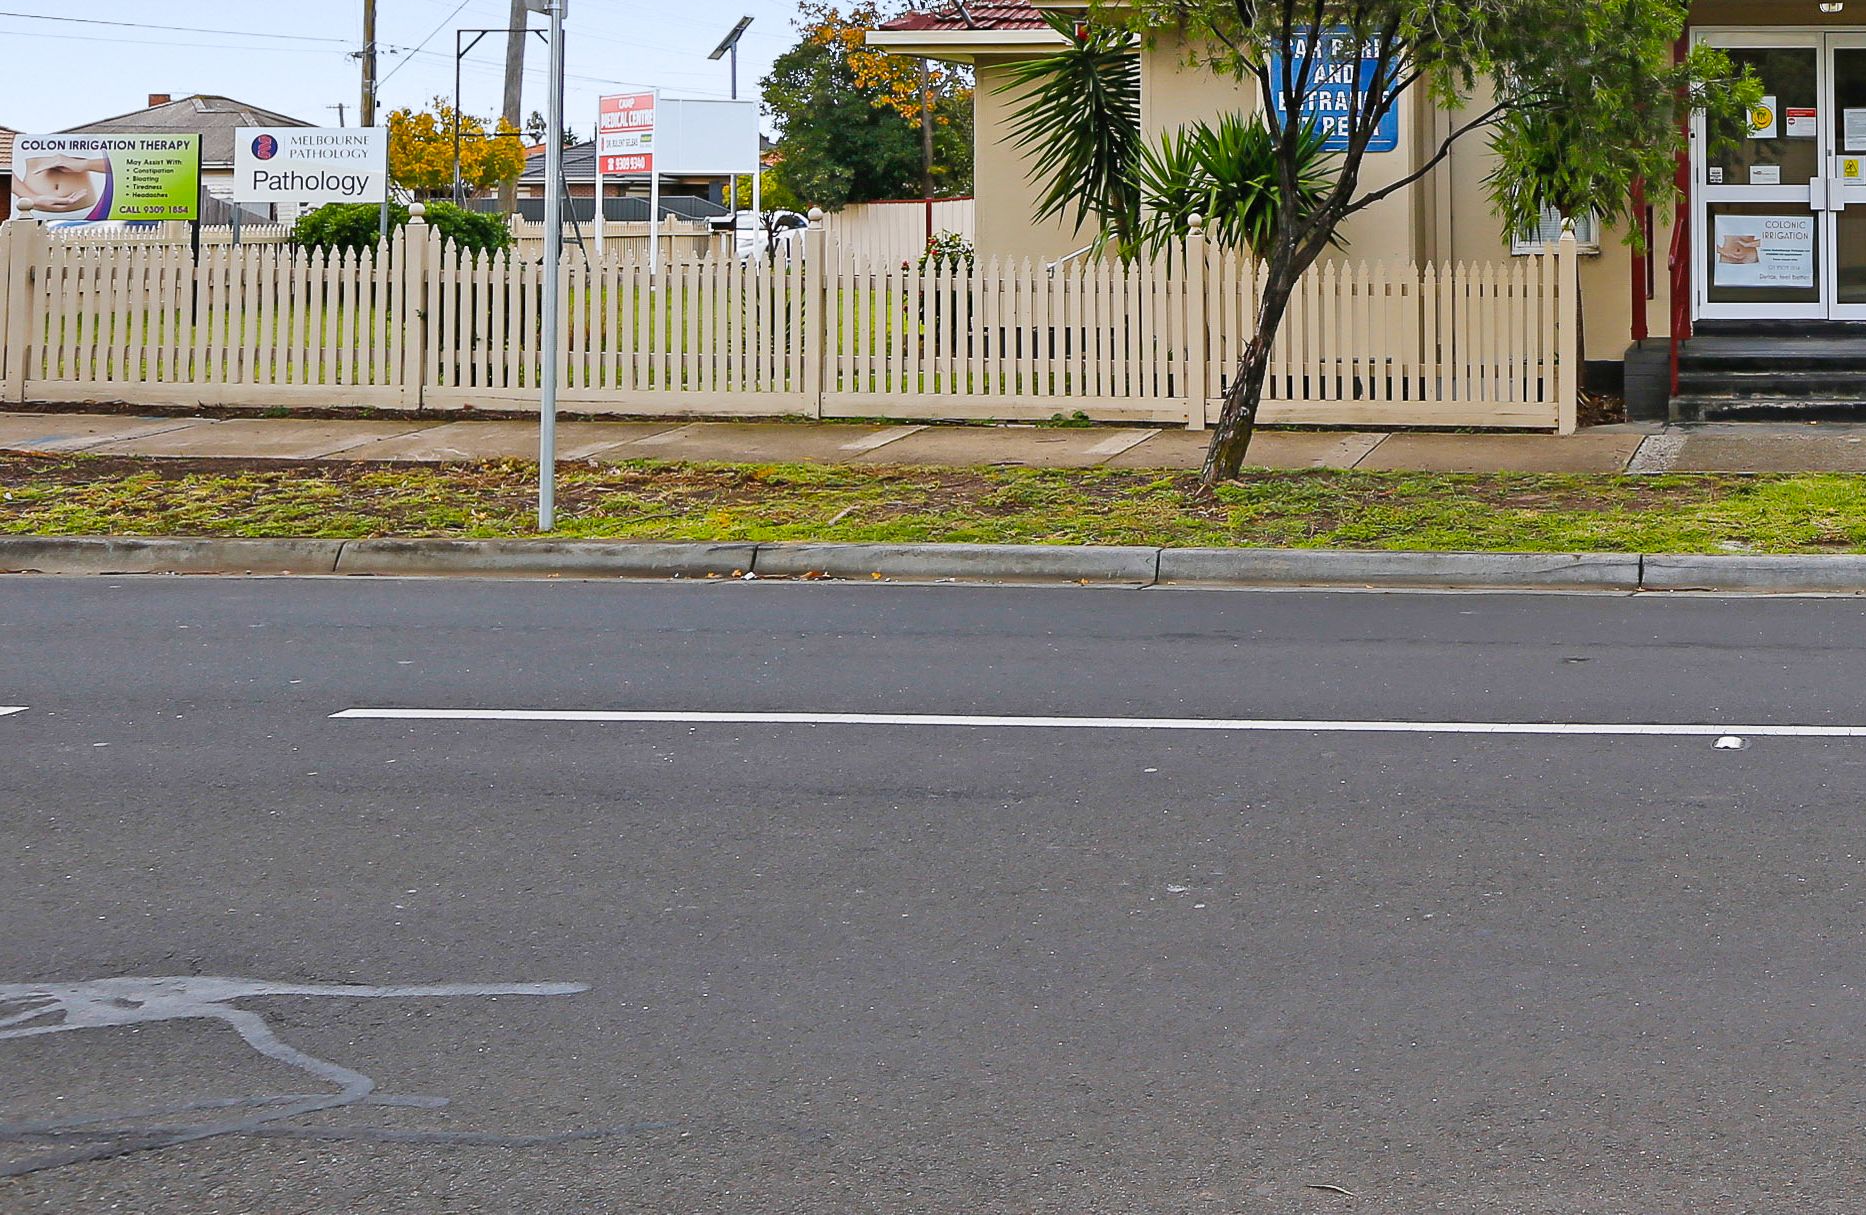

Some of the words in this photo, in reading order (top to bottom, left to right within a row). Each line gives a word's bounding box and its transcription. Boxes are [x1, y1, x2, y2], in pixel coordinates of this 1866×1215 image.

[1313, 64, 1355, 84] AND
[601, 111, 628, 129] MEDICAL
[629, 109, 653, 127] CENTRE
[290, 135, 369, 145] MELBOURNE
[21, 140, 66, 151] COLON
[69, 140, 136, 151] IRRIGATION
[140, 140, 191, 150] THERAPY
[290, 148, 369, 159] PATHOLOGY
[126, 158, 142, 167] May
[144, 158, 164, 166] Assist
[133, 167, 174, 175] Constipation
[132, 175, 159, 183] Bloating
[253, 170, 369, 196] Pathology
[119, 206, 141, 214] CALL
[144, 206, 165, 214] 9309
[168, 206, 189, 214] 1854
[1765, 220, 1806, 229] COLONIC
[1761, 231, 1808, 240] IRRIGATION
